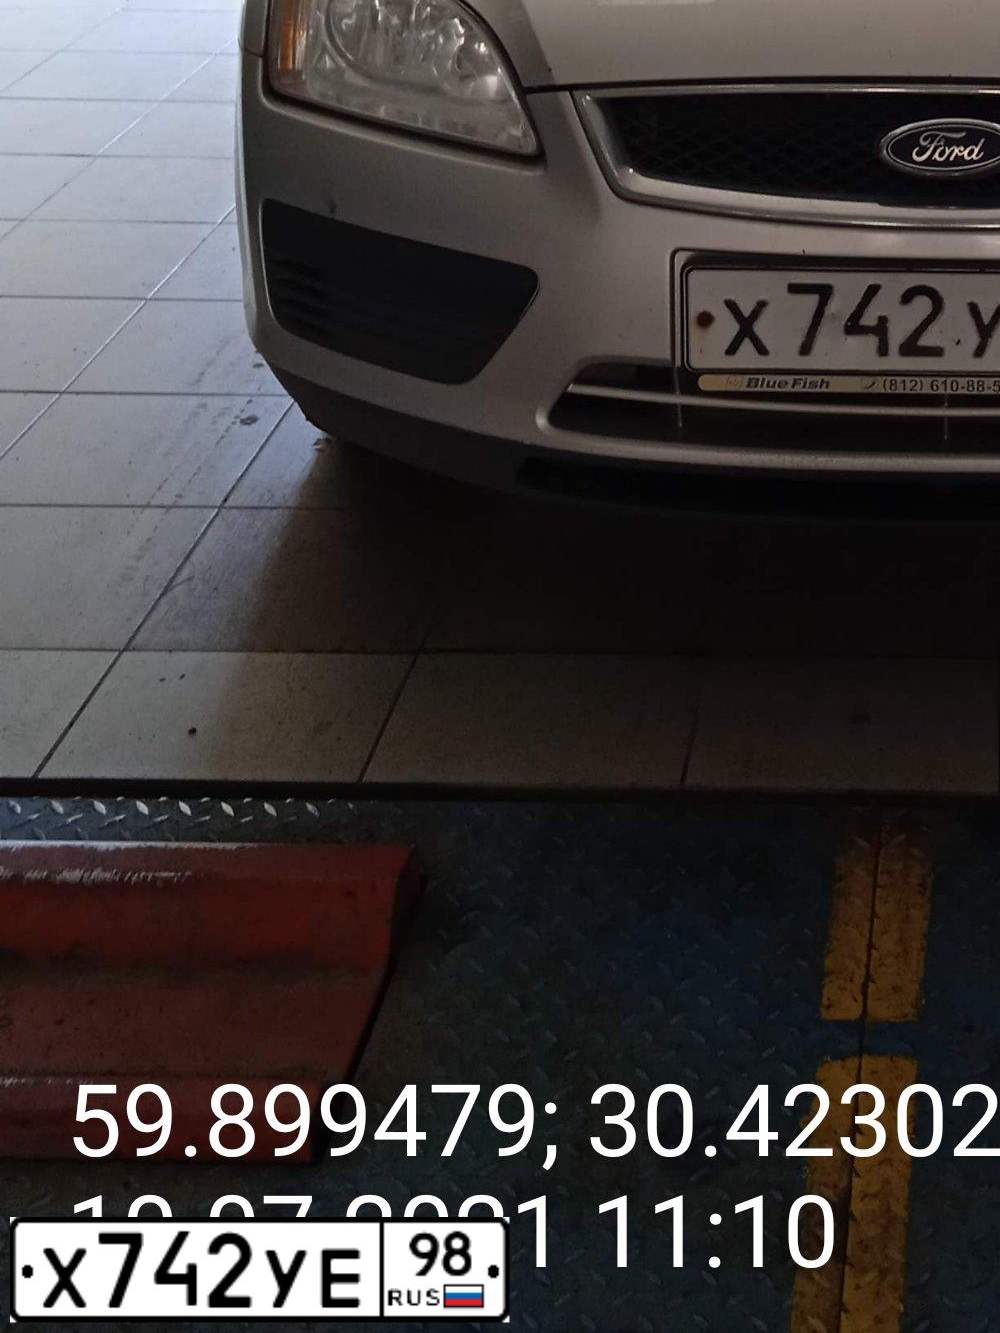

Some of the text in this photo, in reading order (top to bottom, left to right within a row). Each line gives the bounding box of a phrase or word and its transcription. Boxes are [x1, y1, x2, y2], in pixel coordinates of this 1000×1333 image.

[912, 131, 985, 162] Ford
[746, 377, 788, 390] Blue
[791, 378, 830, 390] Fish
[882, 377, 923, 393] (812)
